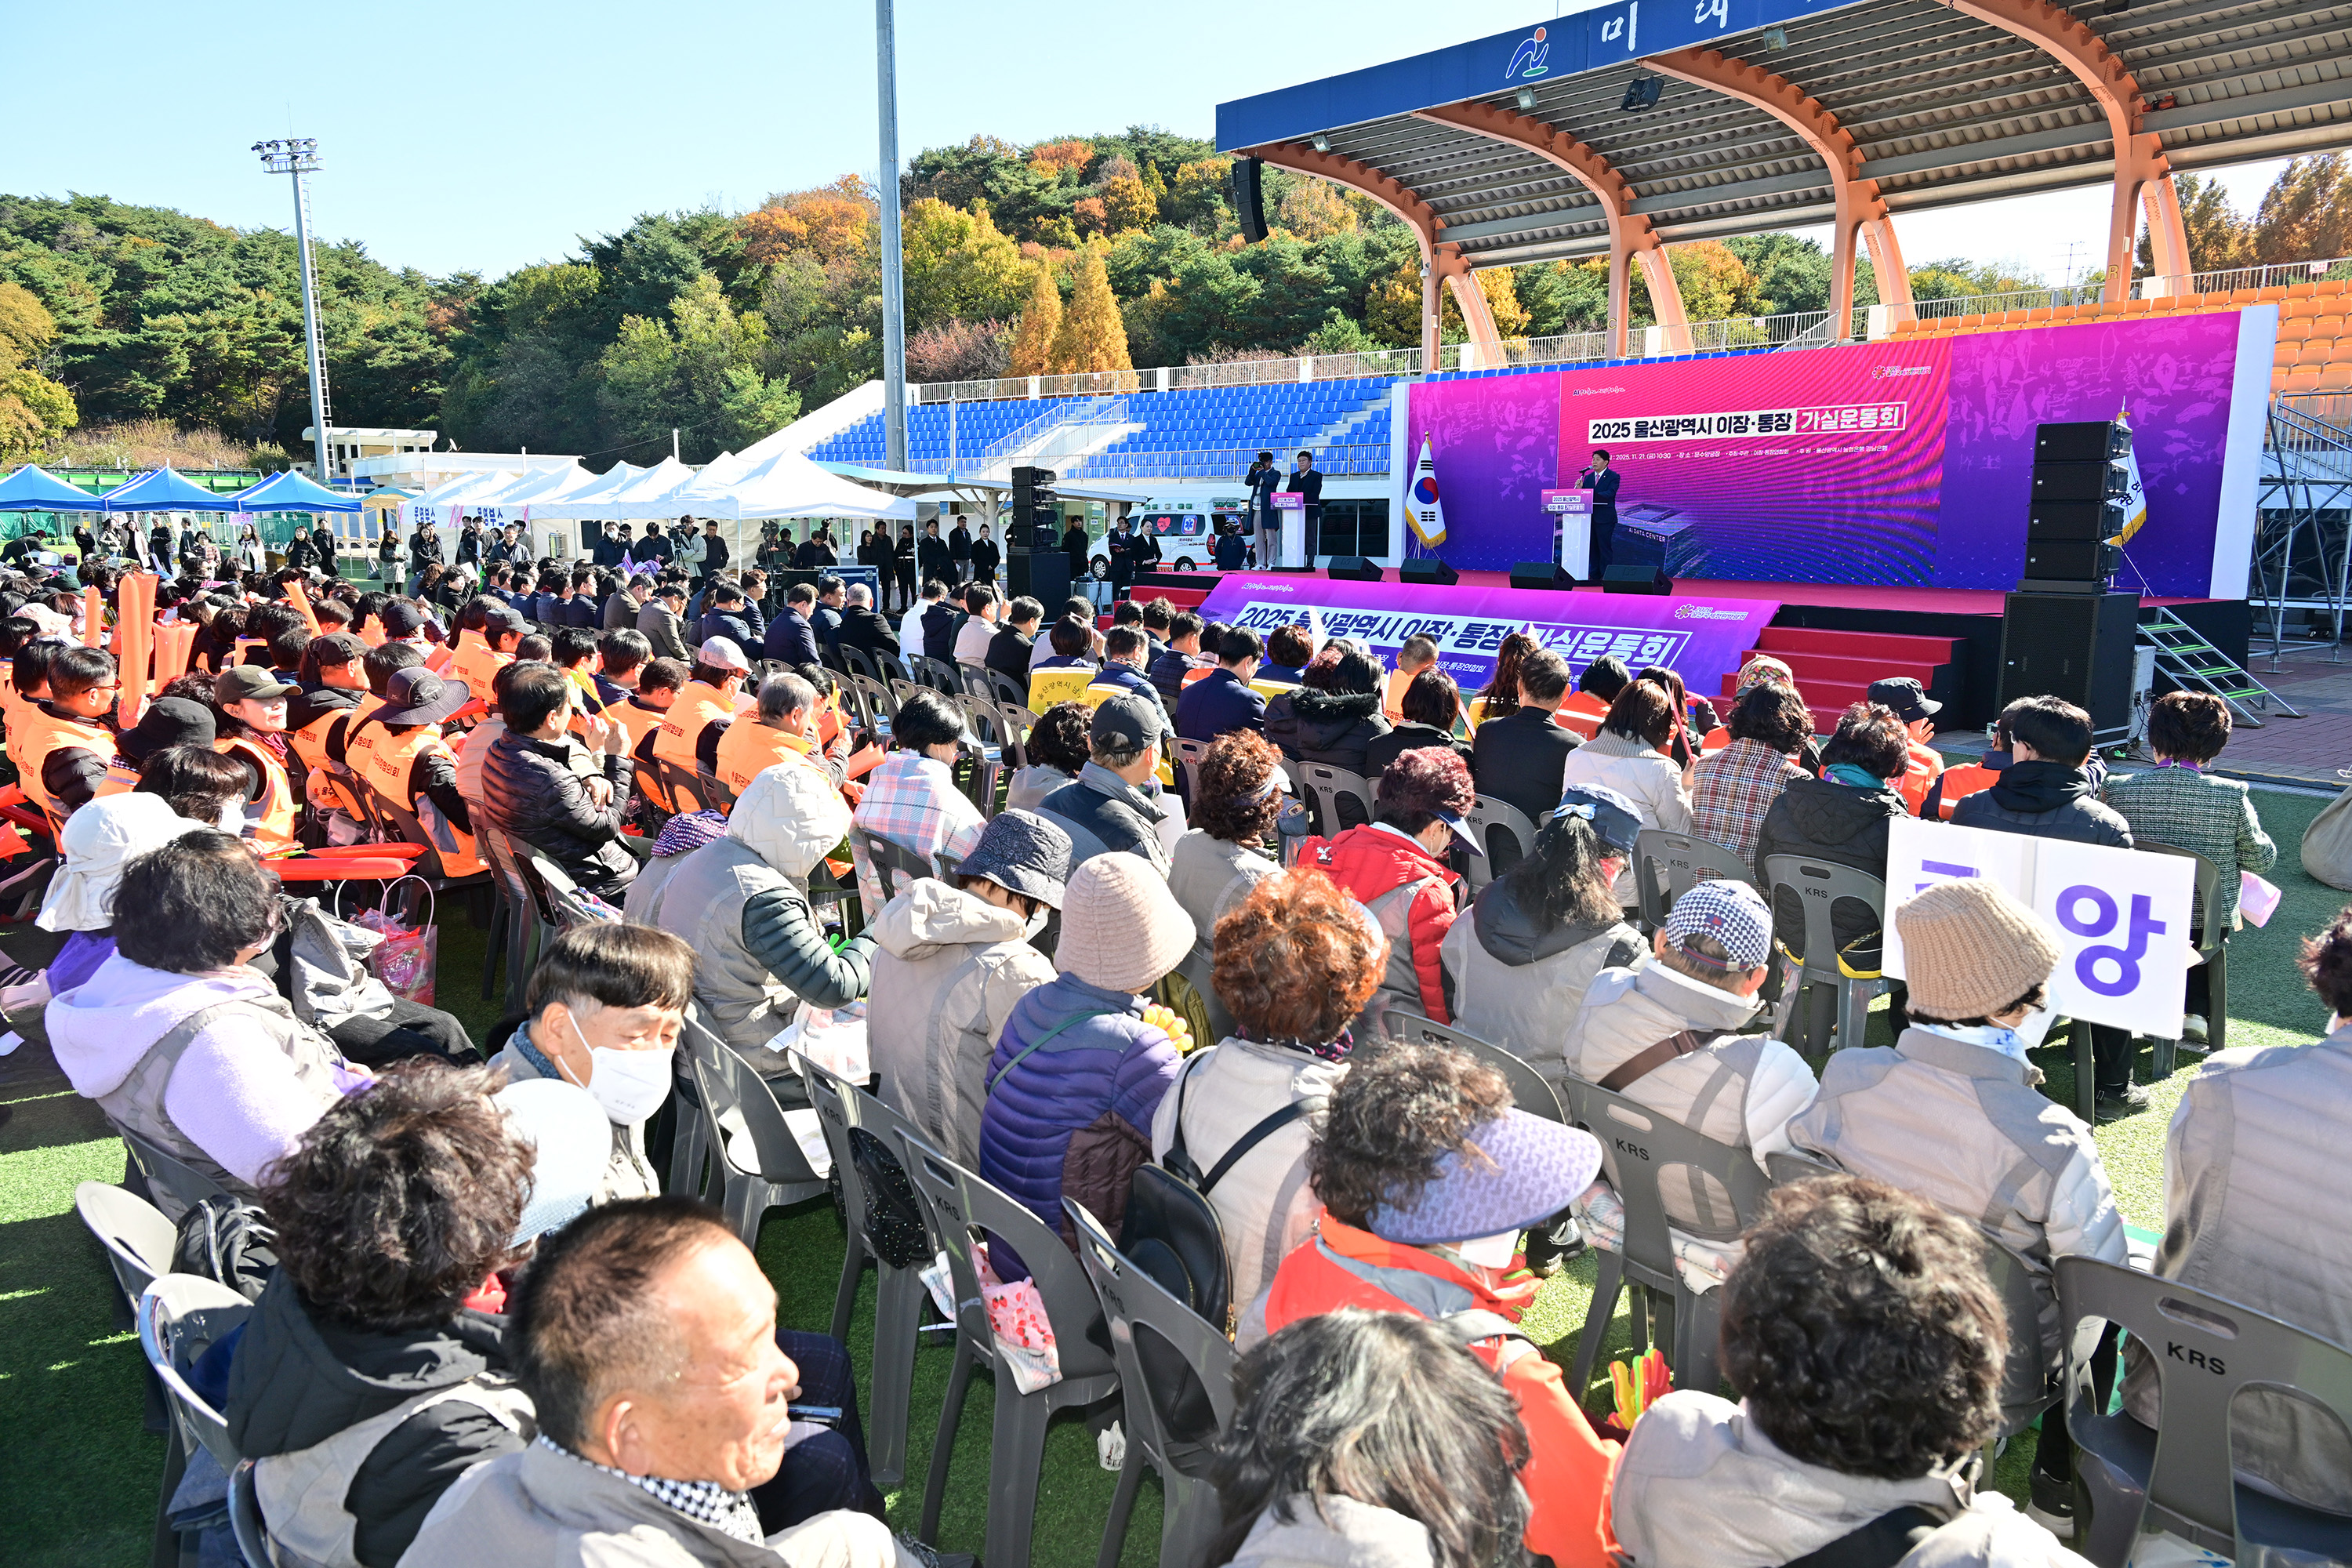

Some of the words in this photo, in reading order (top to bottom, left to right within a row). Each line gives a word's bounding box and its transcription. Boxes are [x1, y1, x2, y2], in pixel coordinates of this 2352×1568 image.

[1592, 422, 1631, 439] 2025
[1634, 417, 1711, 438] 울산광역시
[1716, 412, 1792, 434] 이장·통장
[1801, 406, 1900, 430] 가실운동회
[1633, 528, 1645, 537] DATA
[1646, 532, 1666, 543] CENTER
[1236, 607, 1296, 630] 2025
[1037, 681, 1070, 700] 울산광역시
[1466, 816, 1483, 825] KRS
[1669, 858, 1690, 869] KRS
[1805, 887, 1828, 898] KRS
[822, 1105, 843, 1126] KRS
[1615, 1138, 1650, 1160] KRS
[935, 1194, 960, 1221] KRS
[1100, 1280, 1126, 1315] KRS
[2167, 1341, 2226, 1376] KRS
